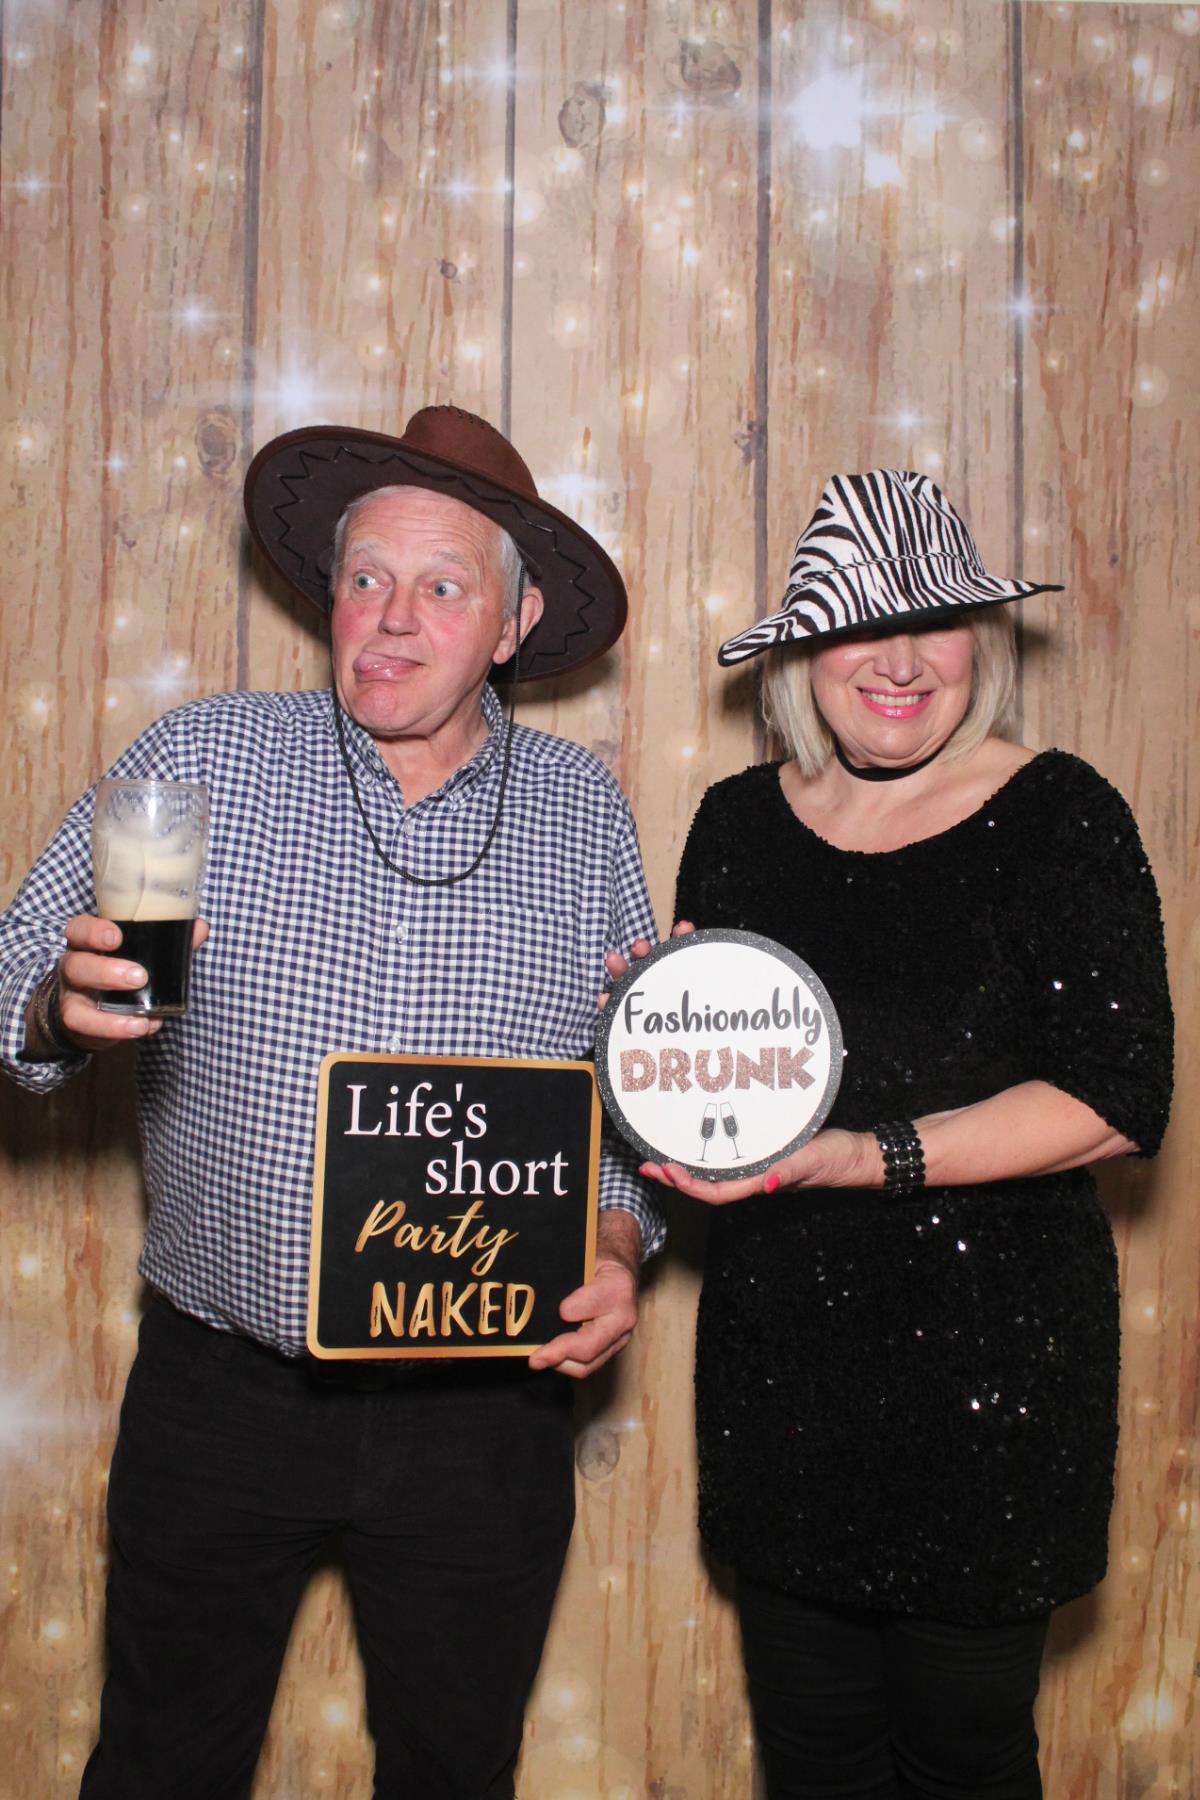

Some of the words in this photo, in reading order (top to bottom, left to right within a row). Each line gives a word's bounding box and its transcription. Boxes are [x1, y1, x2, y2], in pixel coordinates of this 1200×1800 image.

[624, 986, 822, 1045] Fashionably
[620, 1047, 816, 1093] DRUNK
[344, 1082, 487, 1138] Life's
[425, 1140, 569, 1196] short
[354, 1200, 519, 1276] Party
[369, 1281, 535, 1338] NAKED
